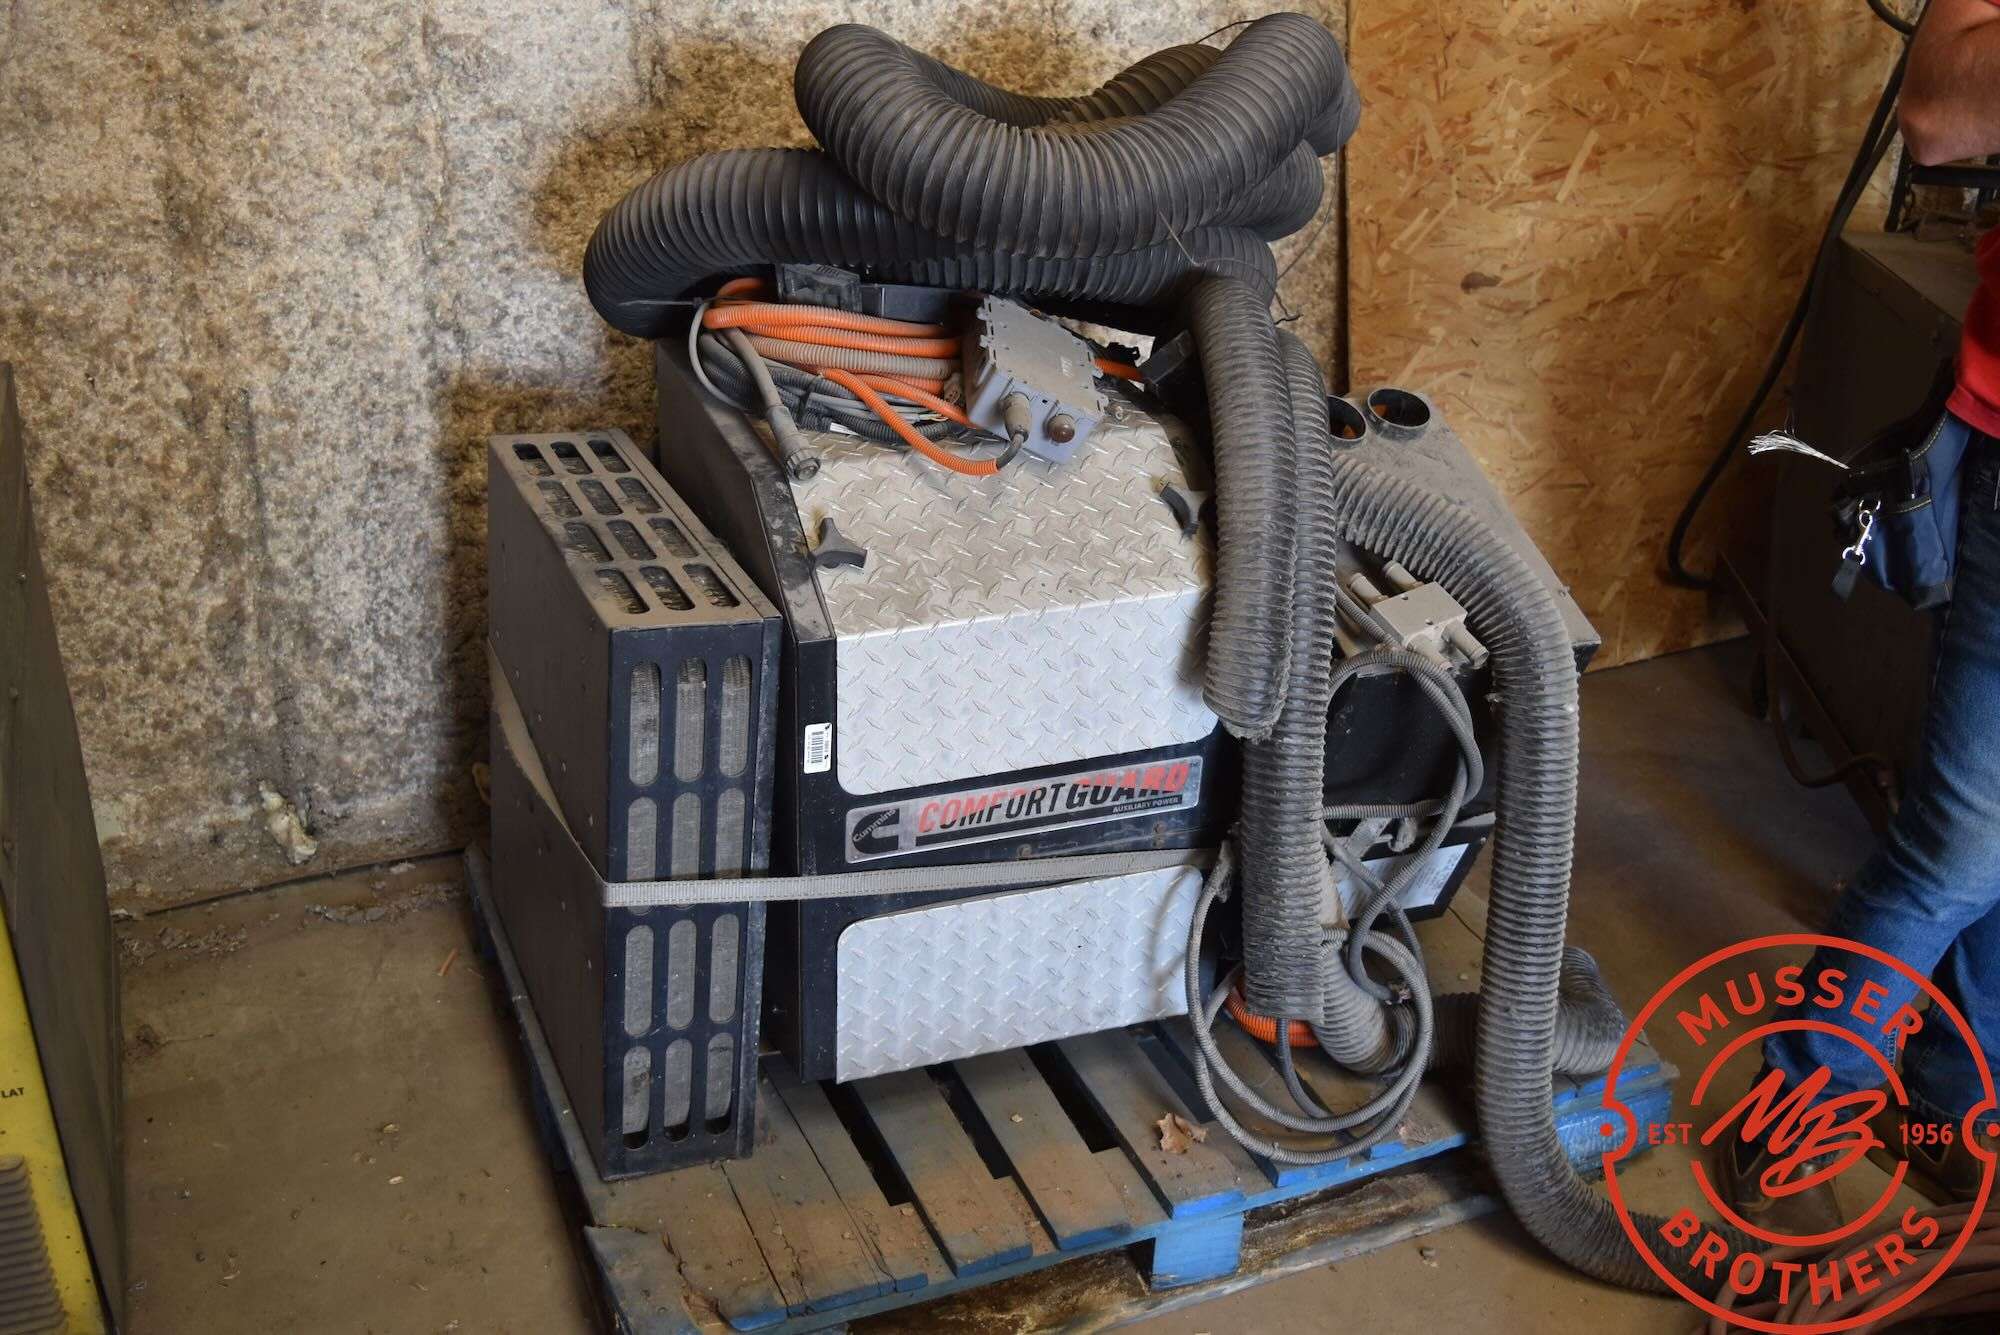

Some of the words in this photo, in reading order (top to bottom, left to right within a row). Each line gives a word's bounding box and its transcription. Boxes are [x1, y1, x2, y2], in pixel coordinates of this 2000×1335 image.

[1112, 801, 1152, 814] AUXILIARY
[1152, 796, 1179, 808] POWER
[852, 809, 896, 842] Cummins
